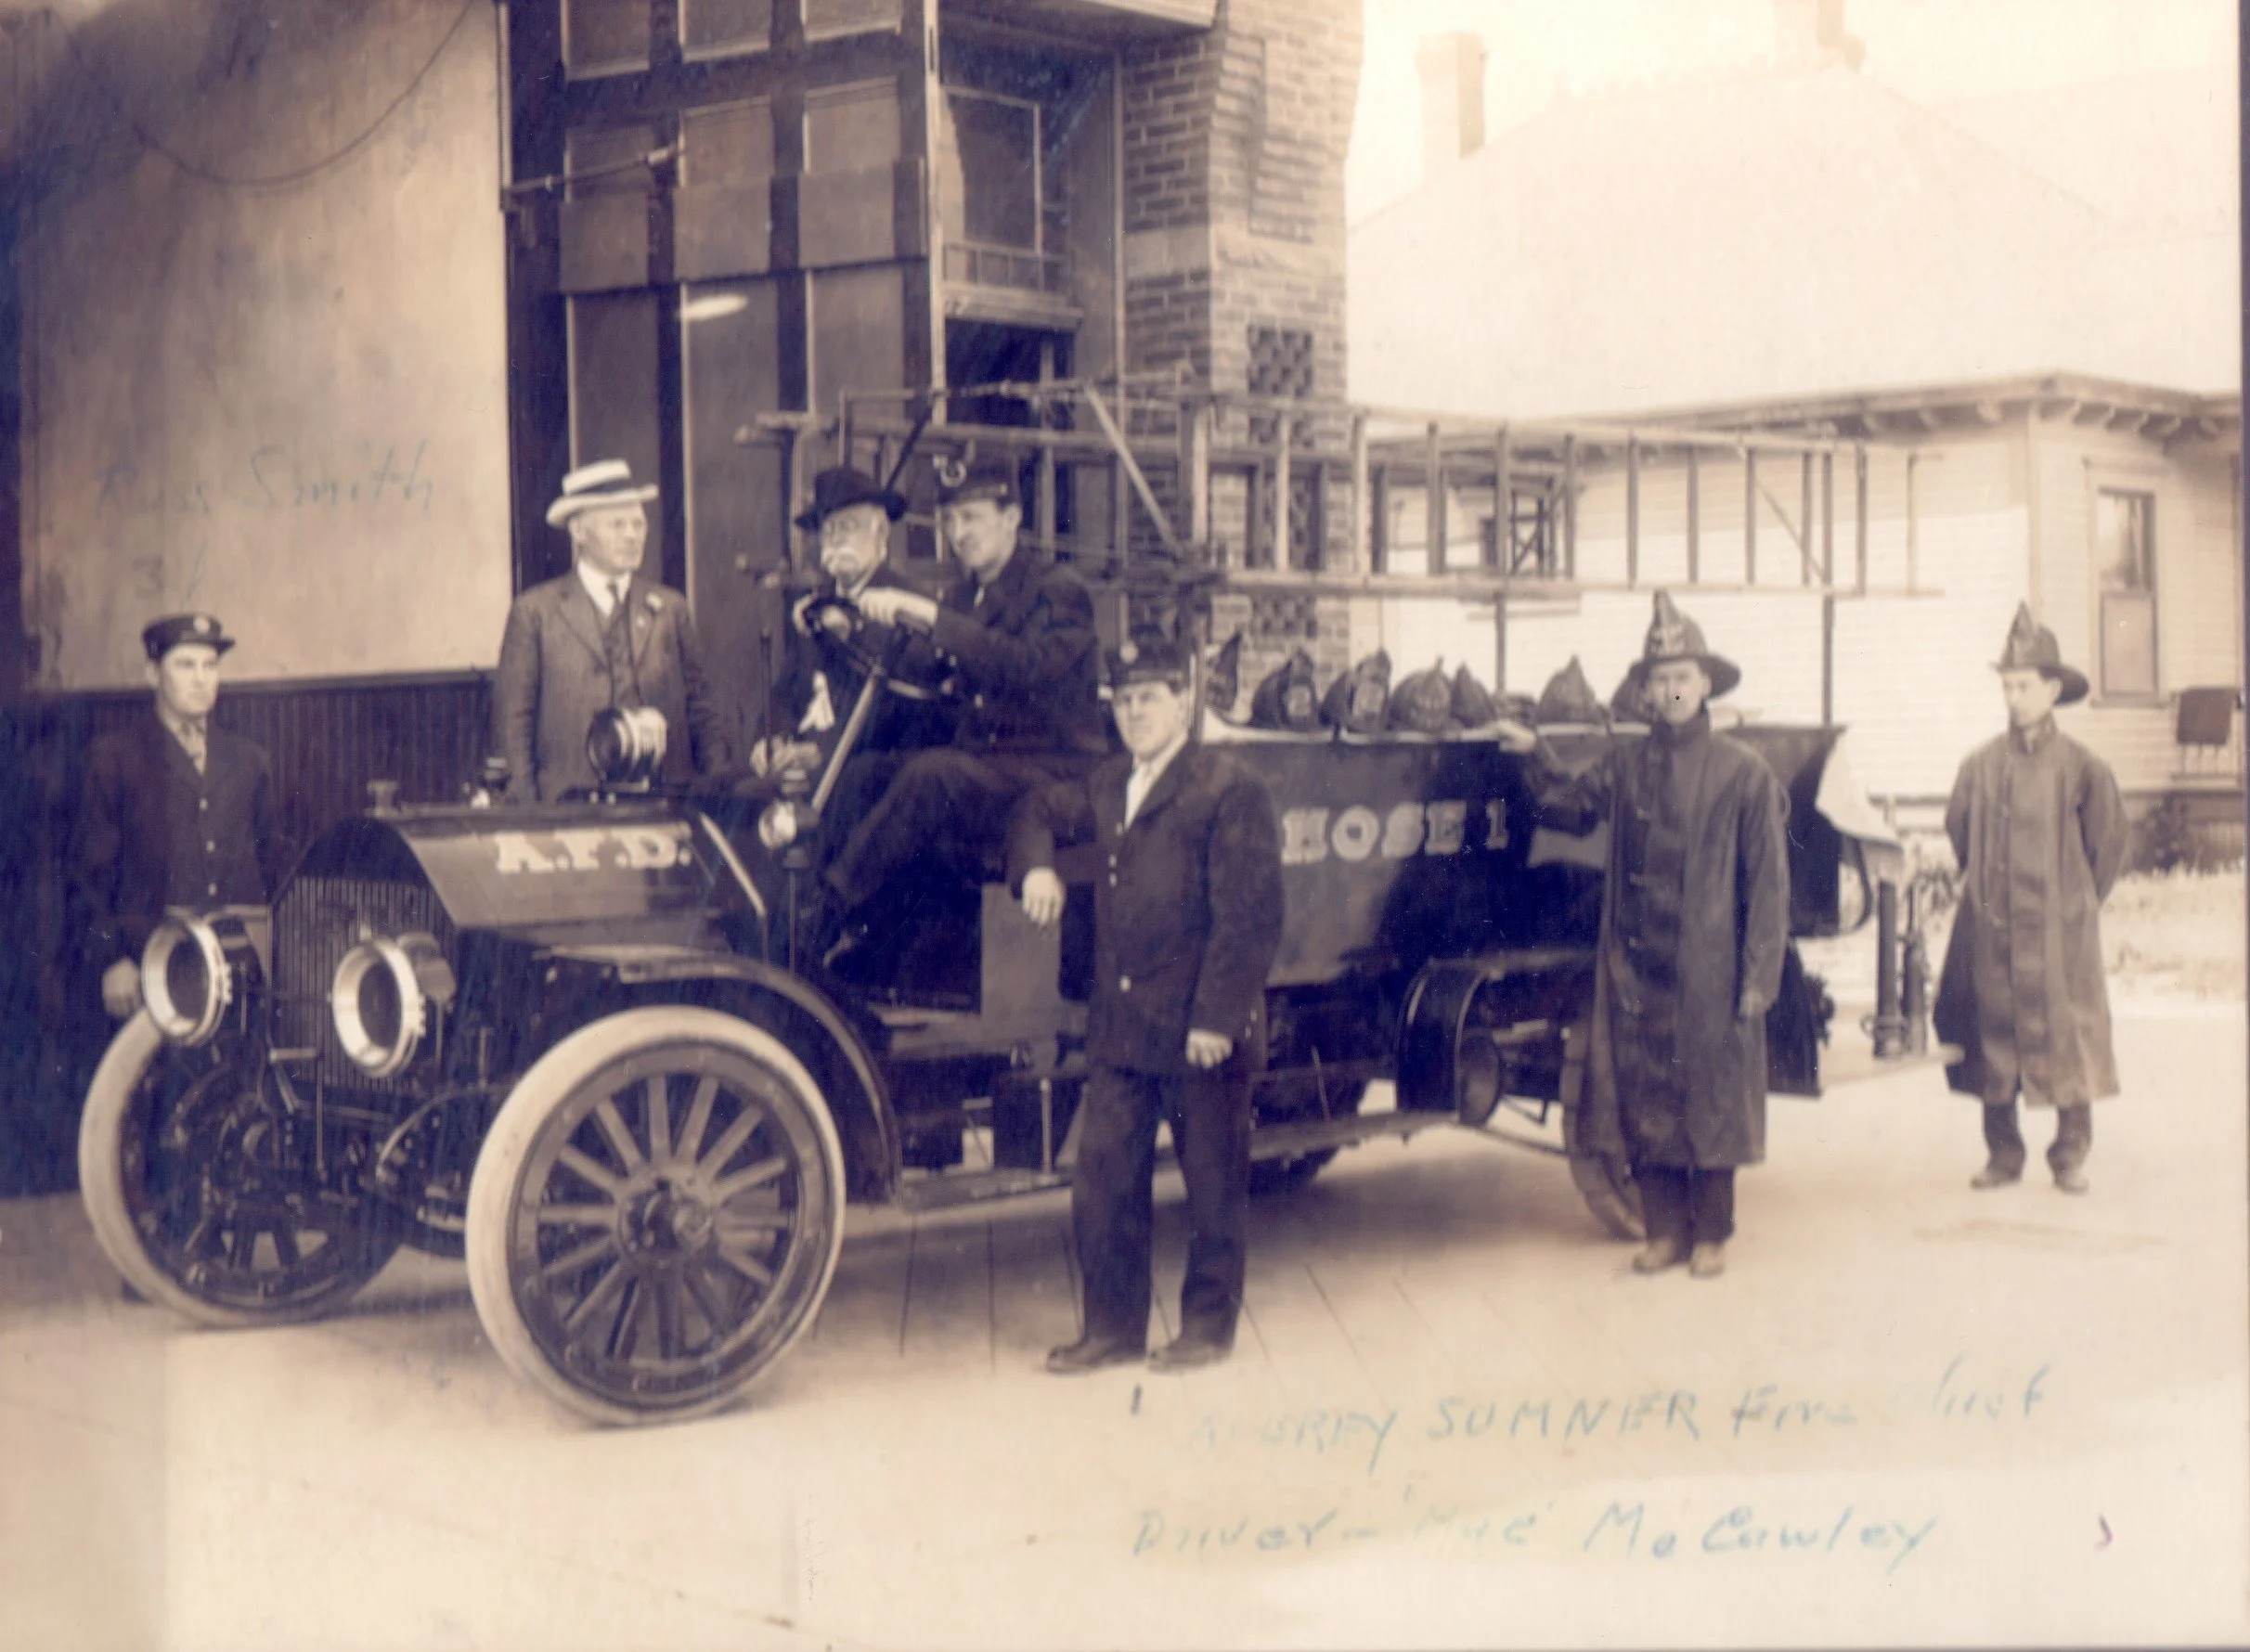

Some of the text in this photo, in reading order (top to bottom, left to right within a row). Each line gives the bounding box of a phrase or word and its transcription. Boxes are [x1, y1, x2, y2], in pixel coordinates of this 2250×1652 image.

[241, 436, 434, 520] Smith
[494, 821, 692, 873] A.F.D.
[1280, 800, 1509, 867] HOSE 1
[1427, 1387, 1701, 1441] SUMNER
